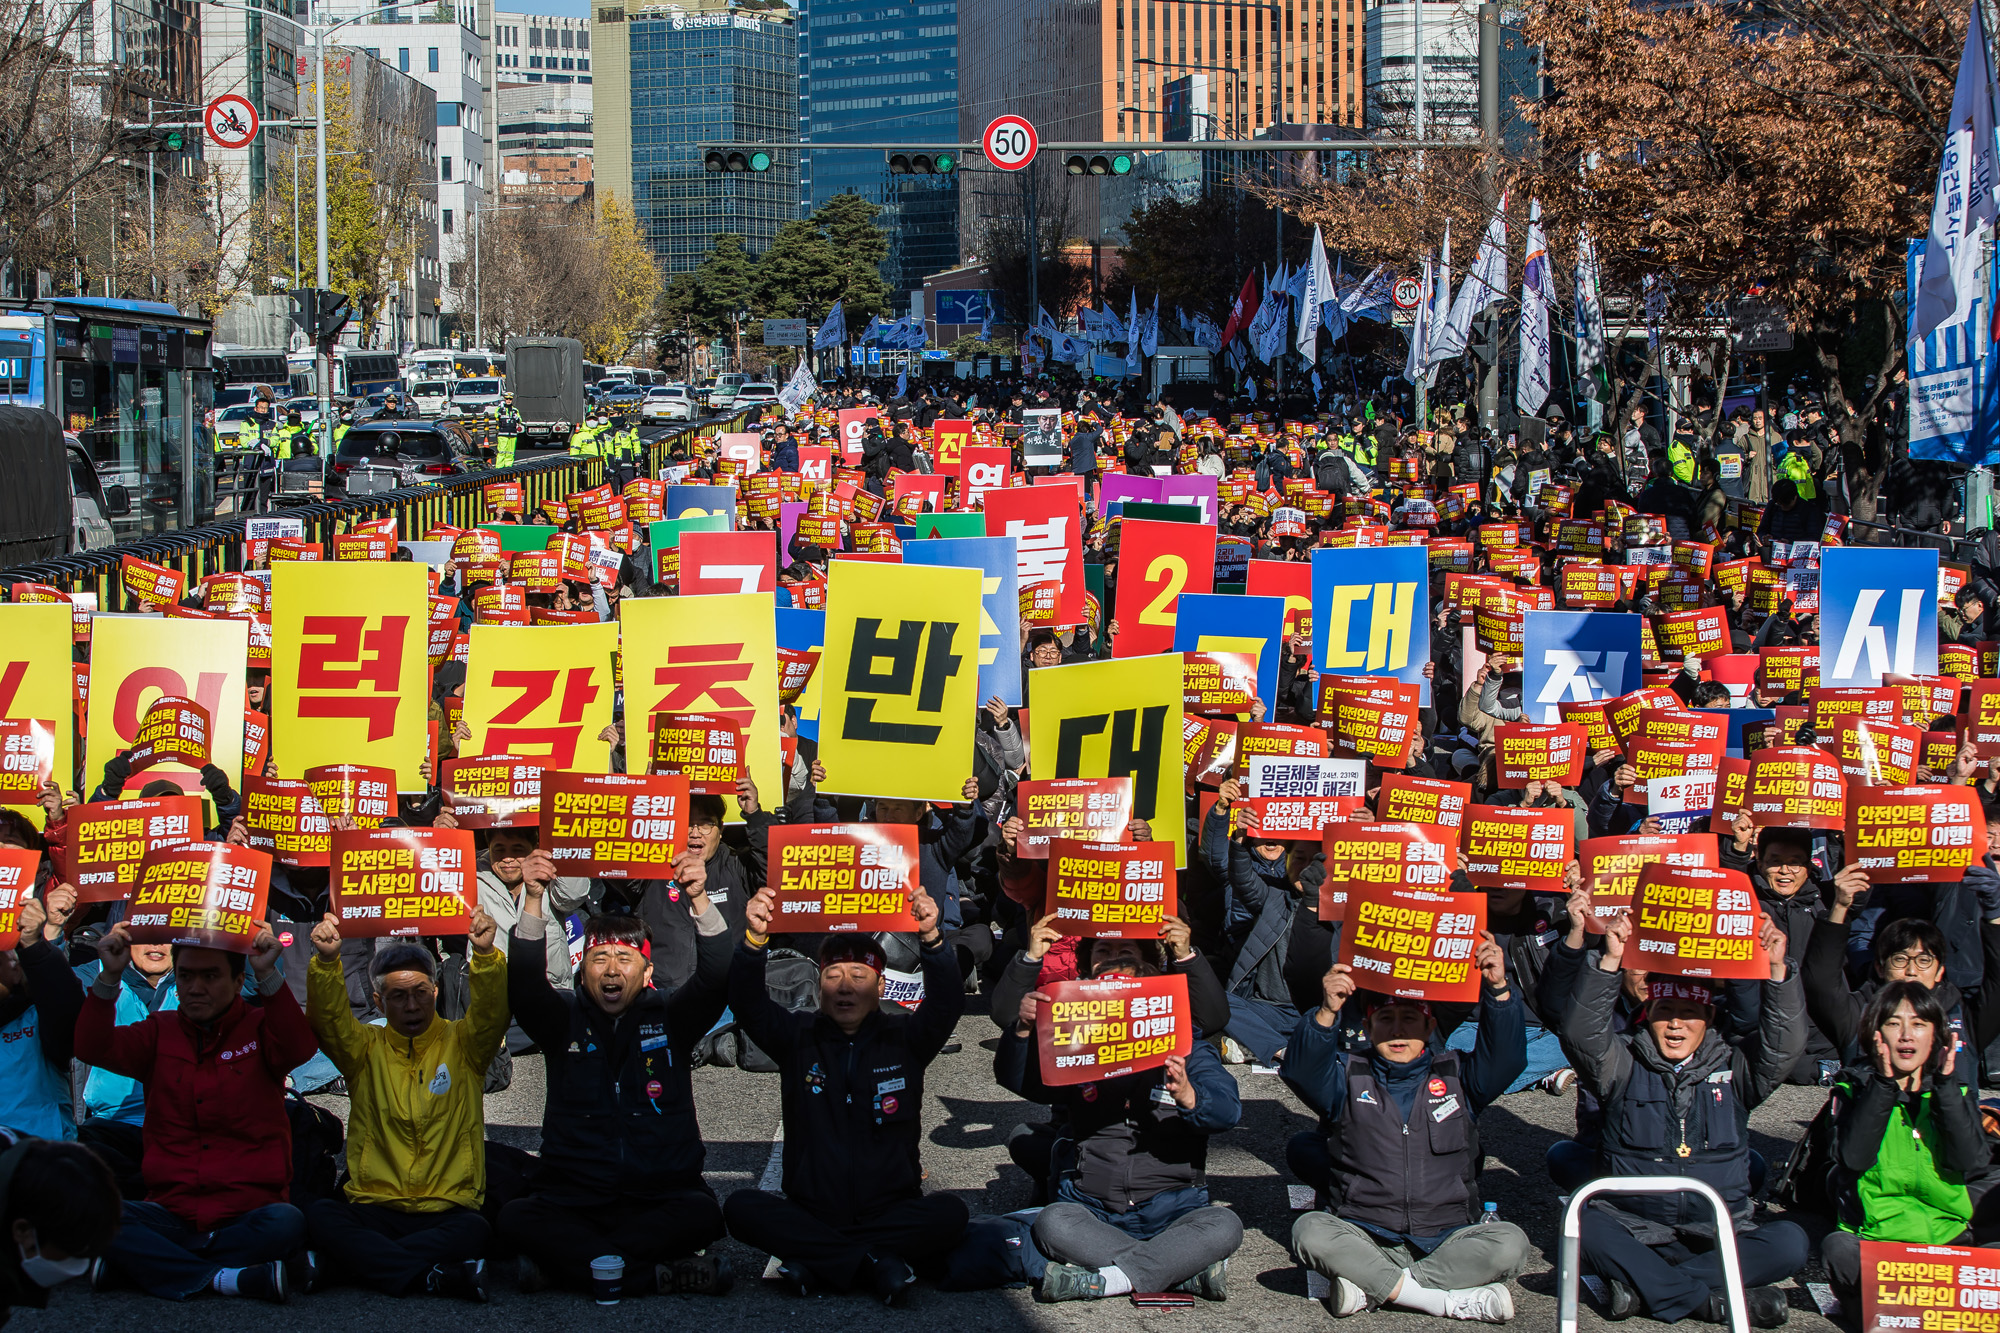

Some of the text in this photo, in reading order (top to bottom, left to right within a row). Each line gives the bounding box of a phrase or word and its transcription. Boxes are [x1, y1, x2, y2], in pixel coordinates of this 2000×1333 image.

[685, 16, 729, 28] 신한라이프
[995, 129, 1027, 156] 50
[1398, 285, 1417, 300] 30
[251, 522, 280, 532] 임금체불
[798, 519, 837, 530] 안전인력 충원!
[798, 526, 837, 537] 노사합의 이행!
[453, 544, 500, 555] 노사합의 이행!
[454, 536, 498, 547] 안전인력 충원!
[809, 535, 836, 545] 임금인상!
[511, 567, 559, 578] 노사합의 이행!
[512, 557, 559, 569] 안전인력 충원!
[125, 574, 175, 598] 노사합의 이행!
[126, 565, 178, 589] 안전인력 충원!
[525, 576, 559, 587] 임금인상!
[1565, 580, 1616, 593] 노사합의 이행!
[1566, 571, 1616, 583] 안전인력 충원!
[1138, 554, 1188, 627] 2
[1582, 589, 1616, 602] 임금인상!
[1325, 581, 1418, 672] 대
[1656, 616, 1721, 636] 안전인력 충원!
[1660, 627, 1722, 645] 노사합의 이행!
[1832, 588, 1926, 680] 시
[1681, 638, 1724, 656] 임금인상!
[297, 615, 410, 742] 력
[842, 616, 963, 746] 반
[482, 666, 600, 770] 감
[1055, 704, 1170, 822] 대
[1261, 764, 1321, 781] 임금체불
[1259, 781, 1357, 798] 근본원인 해결!
[1660, 782, 1716, 799] 4조 2교대
[553, 792, 676, 817] 안전인력 충원!
[1266, 801, 1339, 817] 외주화 중단!
[1683, 796, 1709, 811] 전면
[1856, 803, 1971, 826] 안전인력 충원!
[551, 816, 676, 841] 노사합의 이행!
[1262, 816, 1314, 831] 안전인력
[1470, 819, 1565, 842] 안전인력 충원!
[1660, 817, 1691, 831] 기관사
[1468, 838, 1565, 860] 노사합의 이행!
[1856, 826, 1973, 849] 노사합의 이행!
[341, 847, 462, 872] 안전인력 충원!
[551, 841, 675, 864] 정부기준 임금인상!
[780, 844, 904, 868] 안전인력 충원!
[1857, 847, 1973, 869] 정부기준 임금인상!
[142, 861, 258, 889] 안전인력 충원!
[779, 867, 904, 892] 노사합의 이행!
[1467, 859, 1564, 878] 정부기준 임금인상!
[340, 871, 464, 896] 노사합의 이행!
[135, 883, 256, 912] 노사합의 이행!
[342, 895, 465, 919] 정부기준 임금인상!
[780, 892, 904, 915] 정부기준 임금인상!
[1642, 882, 1751, 912] 안전인력 충원!
[130, 907, 252, 935] 정부기준 임금인상!
[1358, 901, 1476, 935] 안전인력 충원!
[1639, 908, 1754, 937] 노사합의 이행!
[1353, 924, 1474, 960] 노사합의 이행!
[1638, 936, 1754, 962] 정부기준 임금인상!
[1351, 955, 1470, 984] 정부기준 임금인상!
[1652, 982, 1674, 998] 단결
[234, 1041, 259, 1057] 노동당
[1876, 1260, 1954, 1284] 안전인력
[1876, 1285, 1956, 1308] 노사합의
[1878, 1314, 1921, 1329] 정부기준
